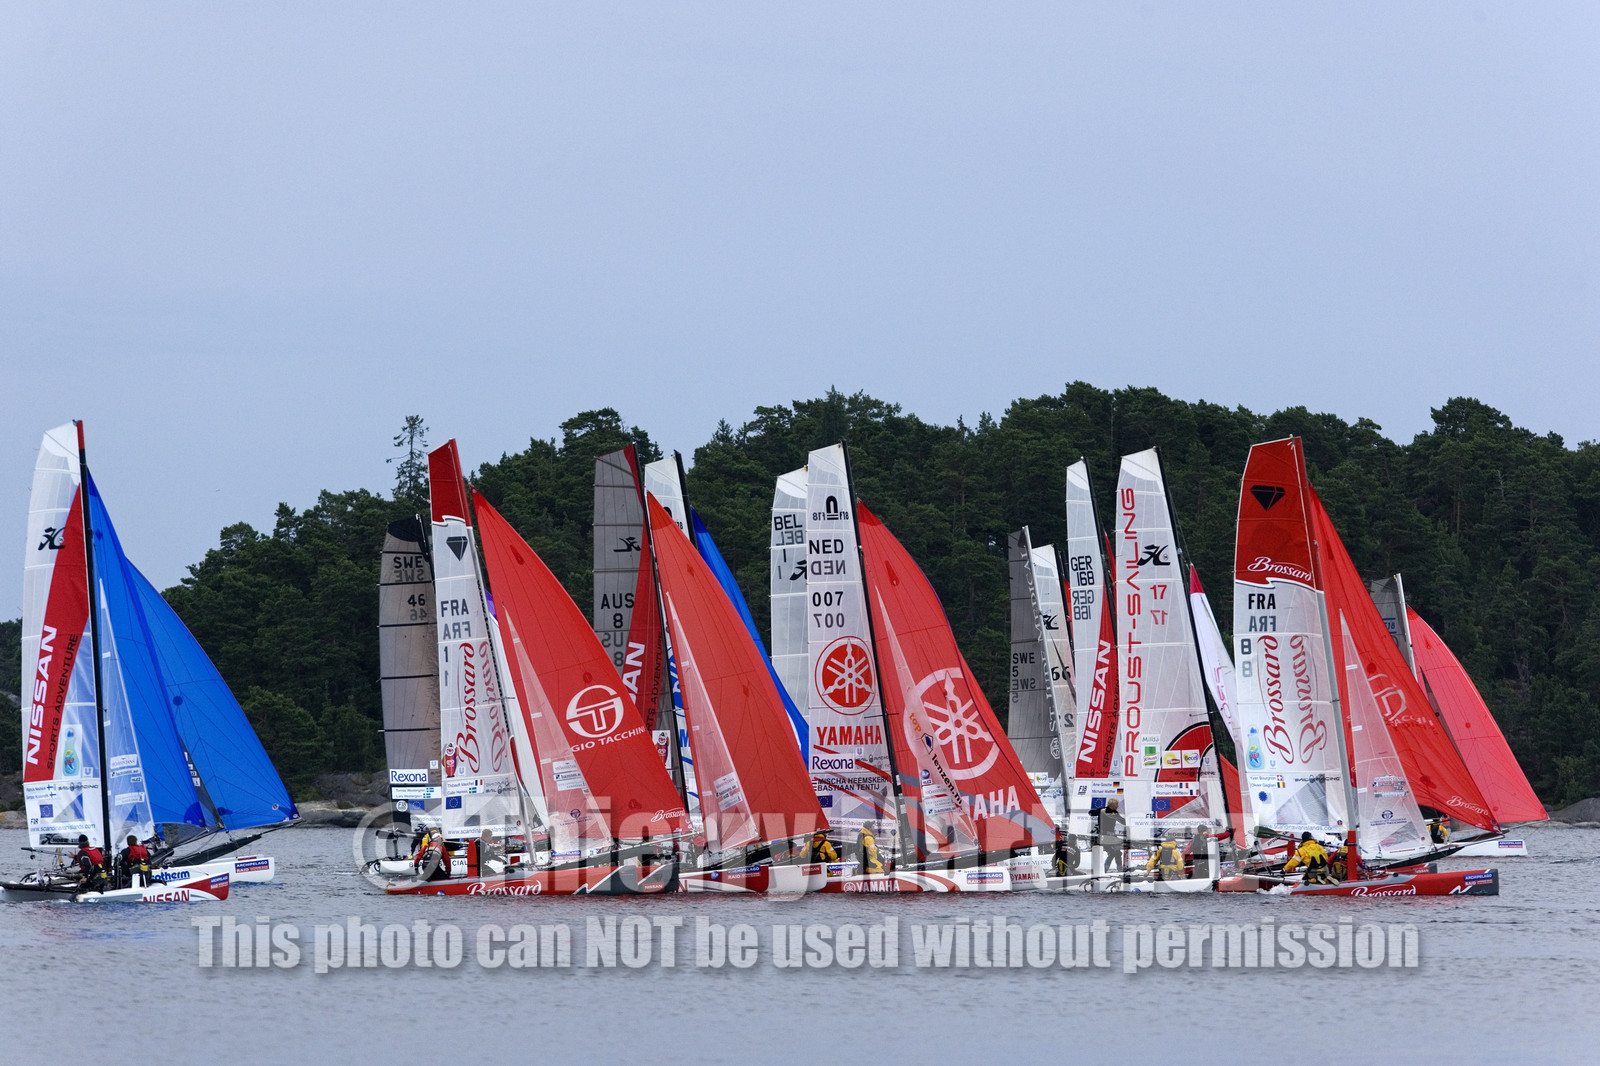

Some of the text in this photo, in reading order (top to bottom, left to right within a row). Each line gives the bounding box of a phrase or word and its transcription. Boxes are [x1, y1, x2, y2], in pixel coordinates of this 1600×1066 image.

[774, 514, 803, 531] BEL
[808, 539, 844, 554] NED
[393, 555, 423, 570] SWE
[1070, 555, 1093, 572] GER
[1247, 556, 1312, 582] Brossard
[1076, 571, 1095, 587] 168
[407, 594, 426, 607] 46
[812, 591, 844, 607] 007
[1150, 585, 1167, 600] 17
[440, 598, 469, 617] FRA
[600, 592, 635, 610] AUS
[1248, 593, 1276, 610] FRA
[613, 612, 623, 629] 8
[1012, 652, 1035, 664] SWE
[1012, 665, 1019, 678] 5
[26, 624, 57, 765] NISSAN
[47, 633, 79, 770] SPORTS ADVENTURE
[1078, 639, 1111, 764] NISSAN
[1258, 634, 1294, 764] Brossard
[456, 642, 481, 774] Brossard
[909, 712, 922, 733] top
[816, 725, 882, 746] YAMAHA
[1102, 722, 1116, 769] SPORTS
[812, 756, 854, 770] Rexona
[391, 770, 427, 783] Rexona
[817, 777, 840, 785] MISCHA
[236, 860, 268, 868] ARCHIPELAGO
[467, 880, 541, 895] Brossard
[856, 880, 900, 892] YAMAHA
[1351, 884, 1416, 896] Brossard
[142, 890, 190, 901] NISSAN
